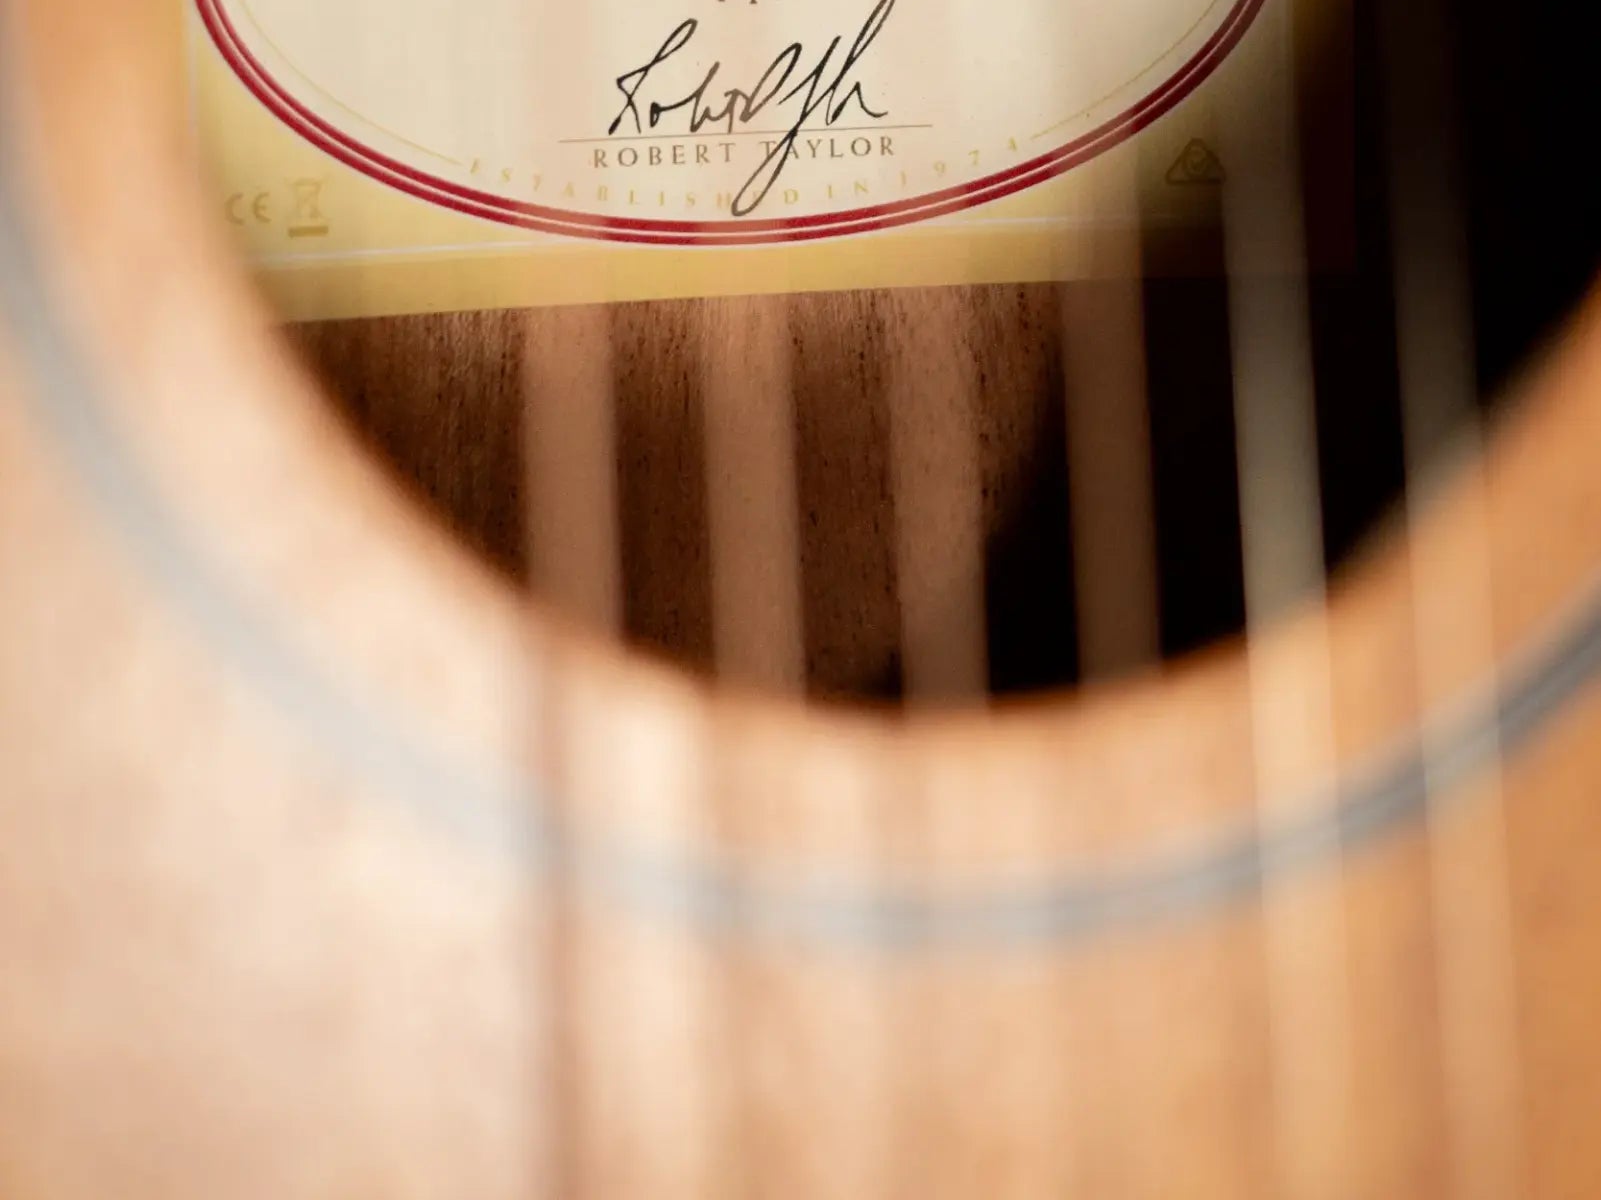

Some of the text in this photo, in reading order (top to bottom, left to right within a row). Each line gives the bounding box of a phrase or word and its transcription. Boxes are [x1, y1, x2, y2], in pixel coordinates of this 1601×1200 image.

[593, 136, 896, 169] ROBERT TAYLOR
[826, 179, 872, 200] IN
[898, 136, 1019, 187] 1974
